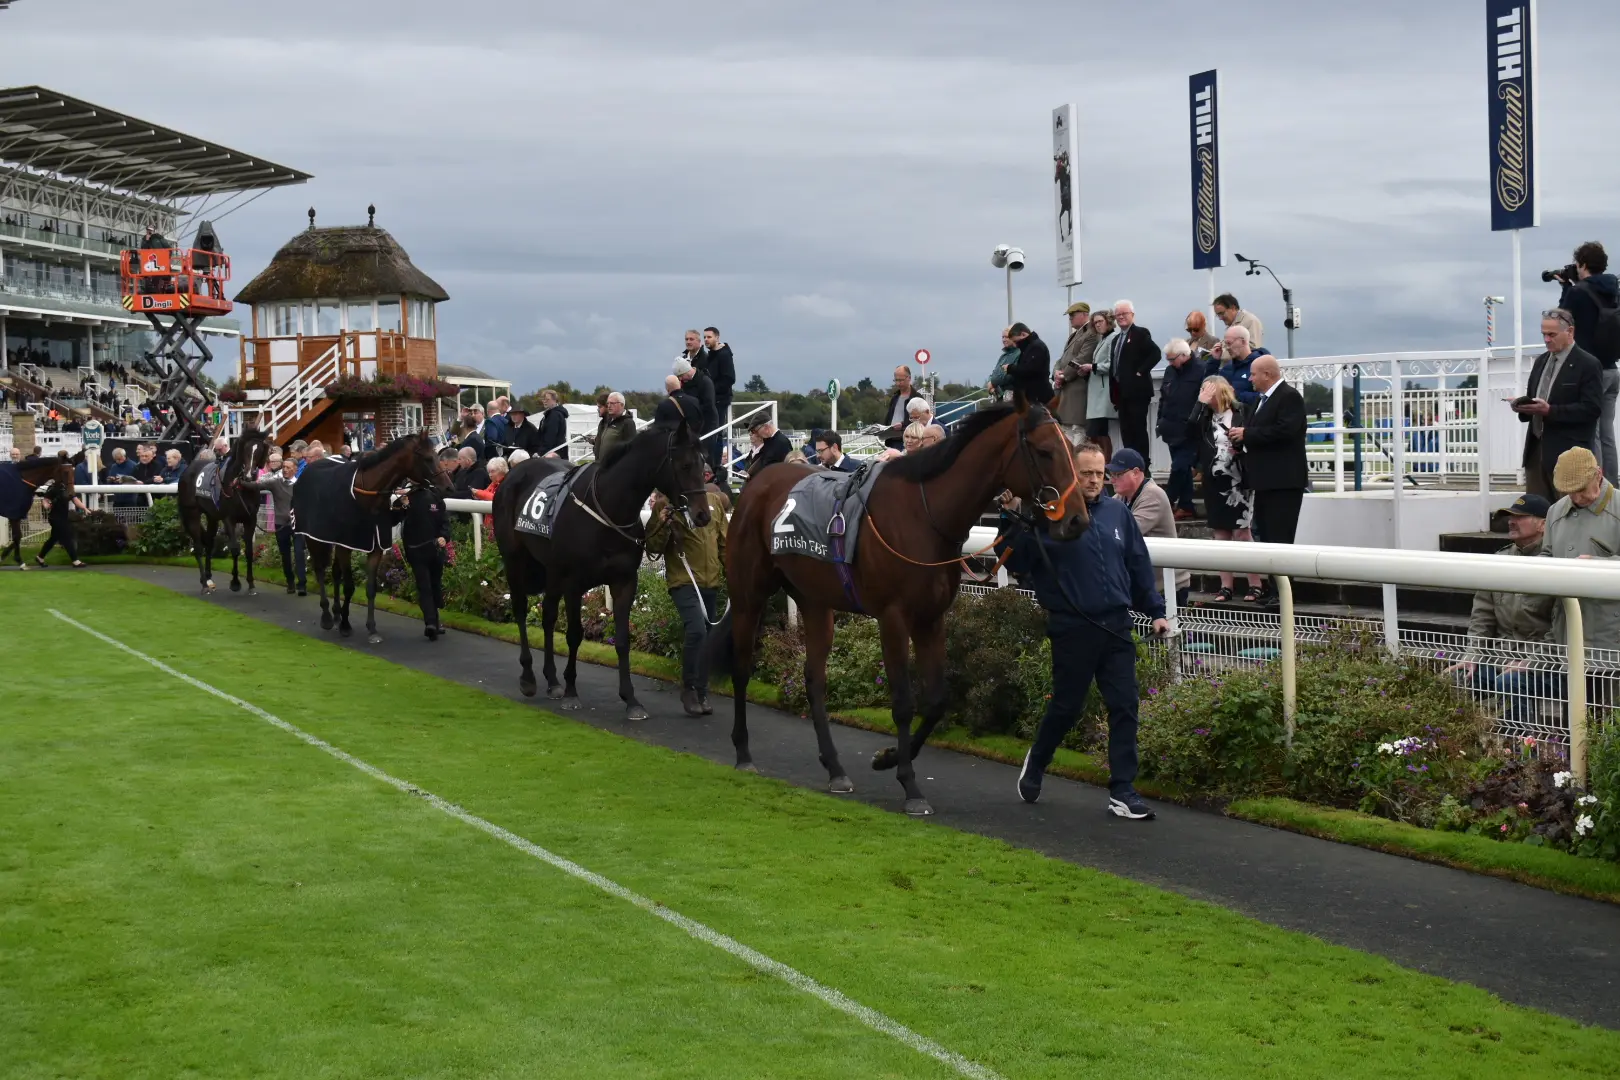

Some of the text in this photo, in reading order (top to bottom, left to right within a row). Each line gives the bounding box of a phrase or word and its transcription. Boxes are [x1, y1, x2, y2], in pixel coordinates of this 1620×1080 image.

[1496, 7, 1526, 211] William HILL
[1195, 85, 1217, 253] William HILL
[142, 296, 172, 309] Dingli
[85, 431, 100, 439] York
[196, 472, 204, 487] 6
[522, 490, 548, 520] 16
[774, 498, 797, 533] 2
[773, 535, 828, 556] British EBF
